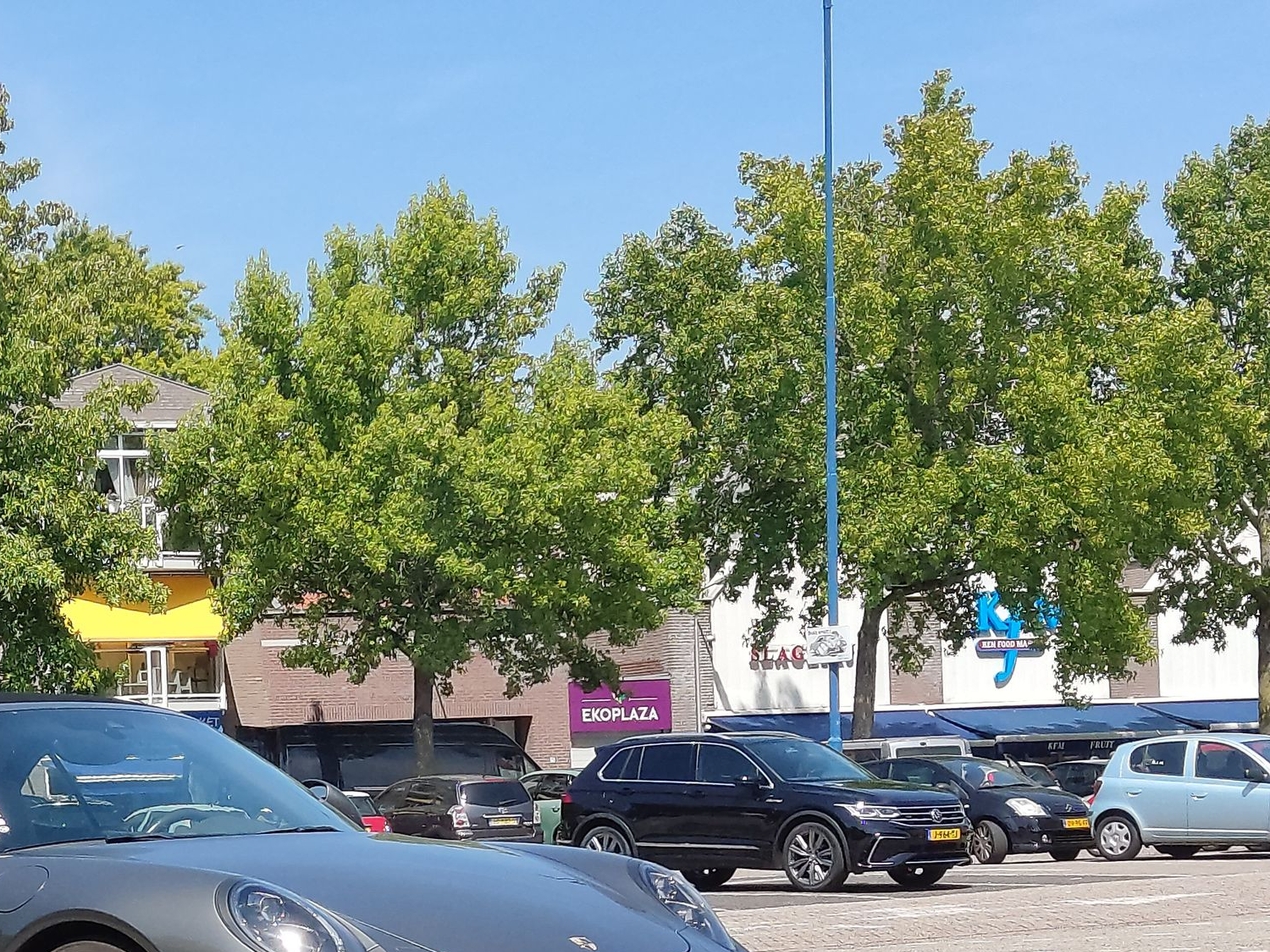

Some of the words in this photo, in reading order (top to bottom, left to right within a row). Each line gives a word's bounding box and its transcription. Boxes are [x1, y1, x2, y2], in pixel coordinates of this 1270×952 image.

[997, 640, 1015, 648] FOOD
[581, 706, 659, 722] EKOPLAZA
[1090, 740, 1115, 750] FRUIT
